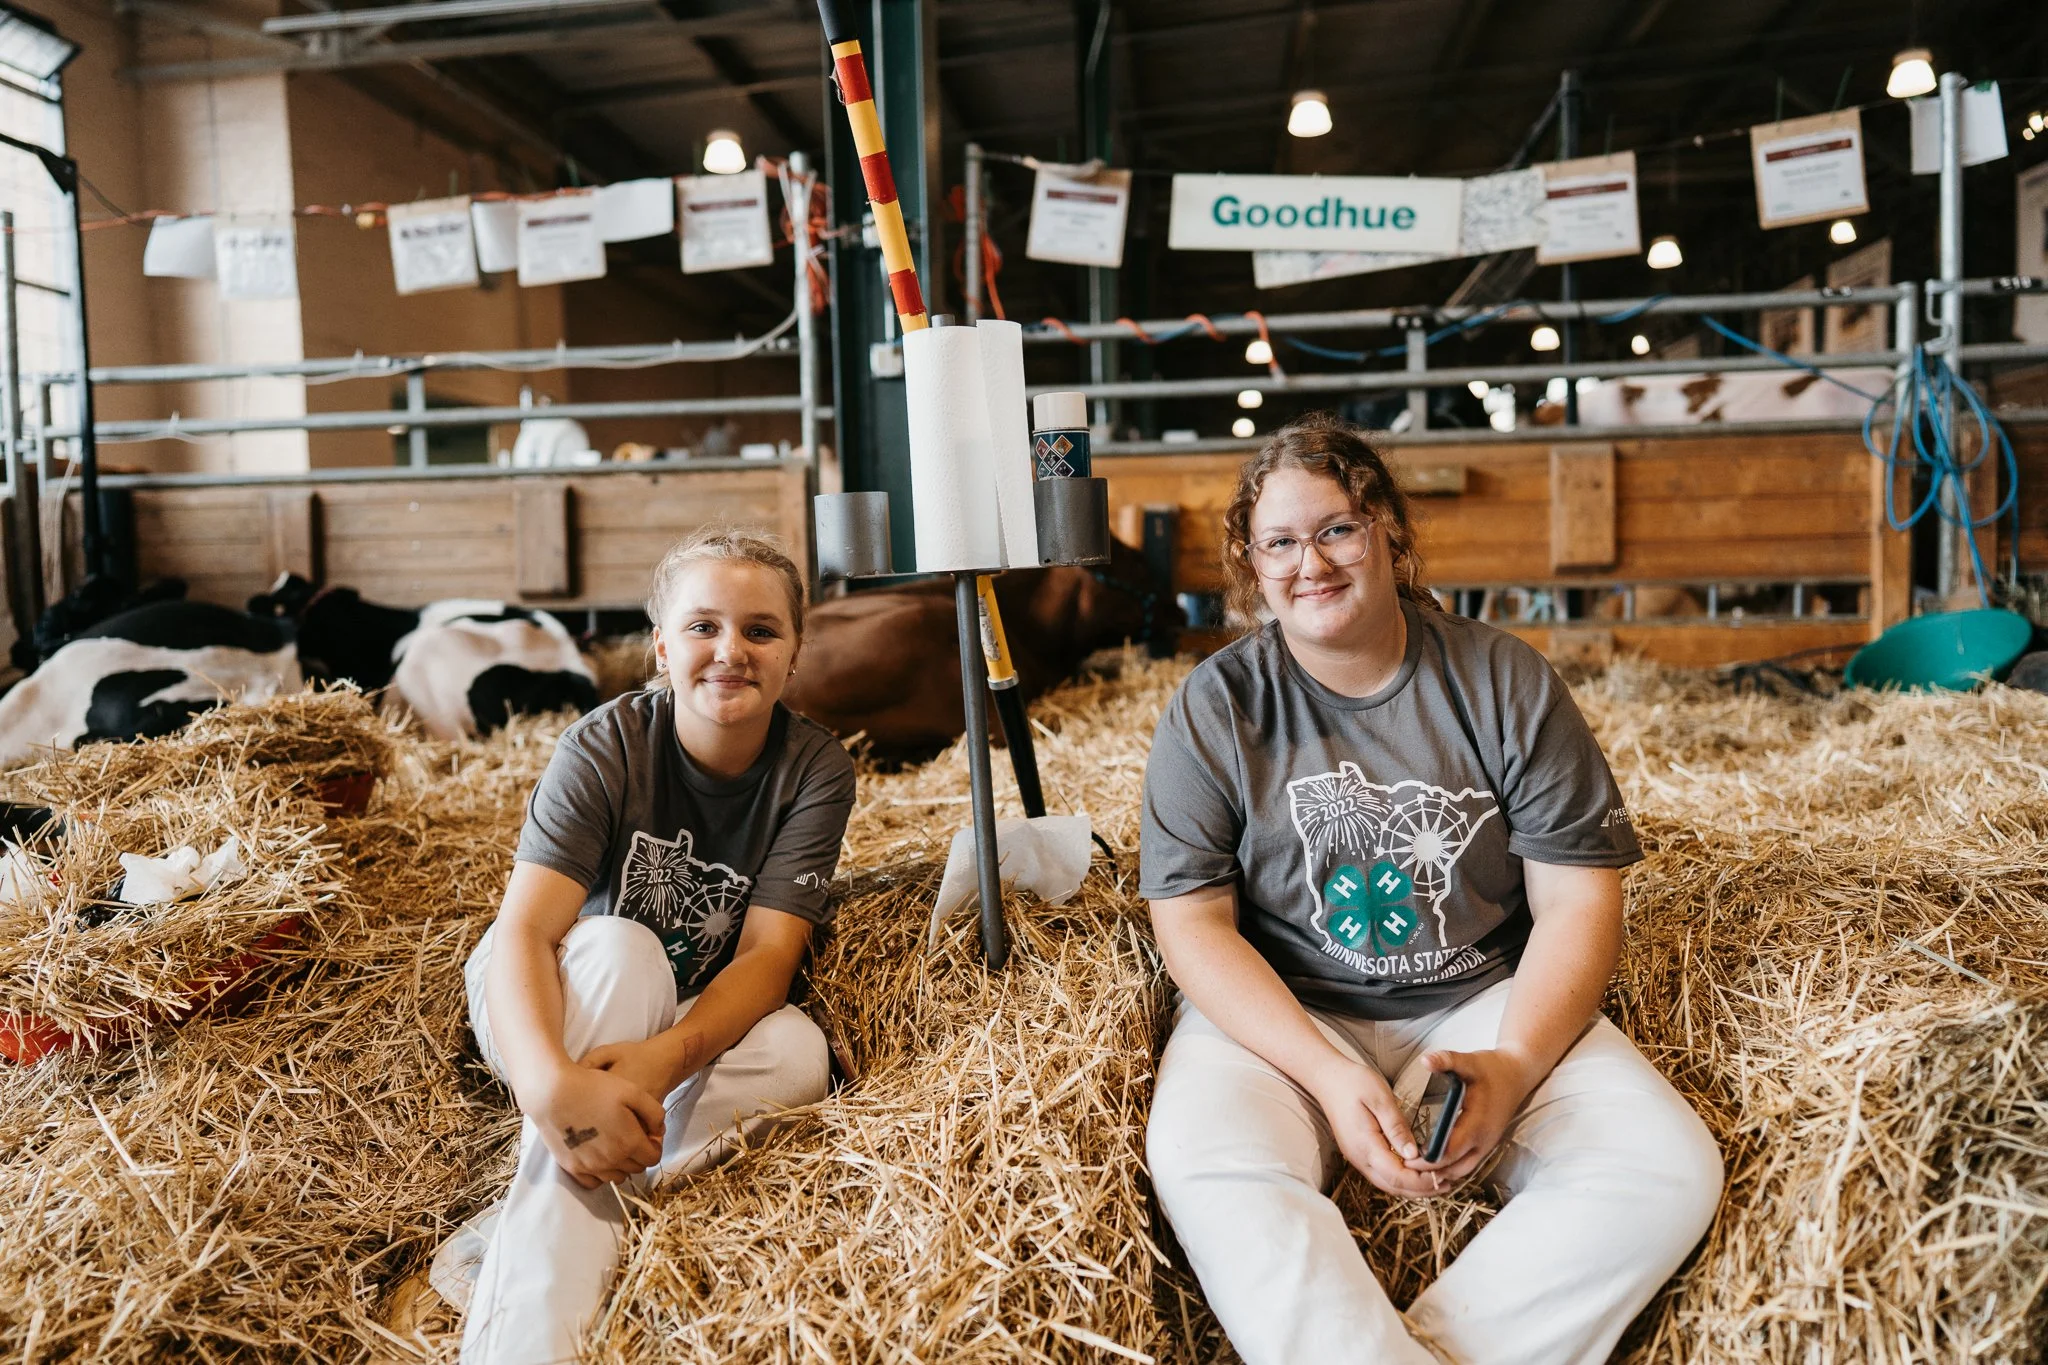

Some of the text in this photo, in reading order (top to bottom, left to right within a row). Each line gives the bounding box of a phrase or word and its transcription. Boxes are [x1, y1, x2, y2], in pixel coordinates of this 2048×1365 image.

[1211, 195, 1417, 230] Goodhue
[1320, 797, 1358, 822] 2022
[647, 869, 672, 884] 2022
[1333, 870, 1401, 899] H H
[1338, 916, 1362, 939] H
[1383, 911, 1408, 936] H
[666, 940, 688, 956] H
[1321, 940, 1411, 976] MINNESOTA
